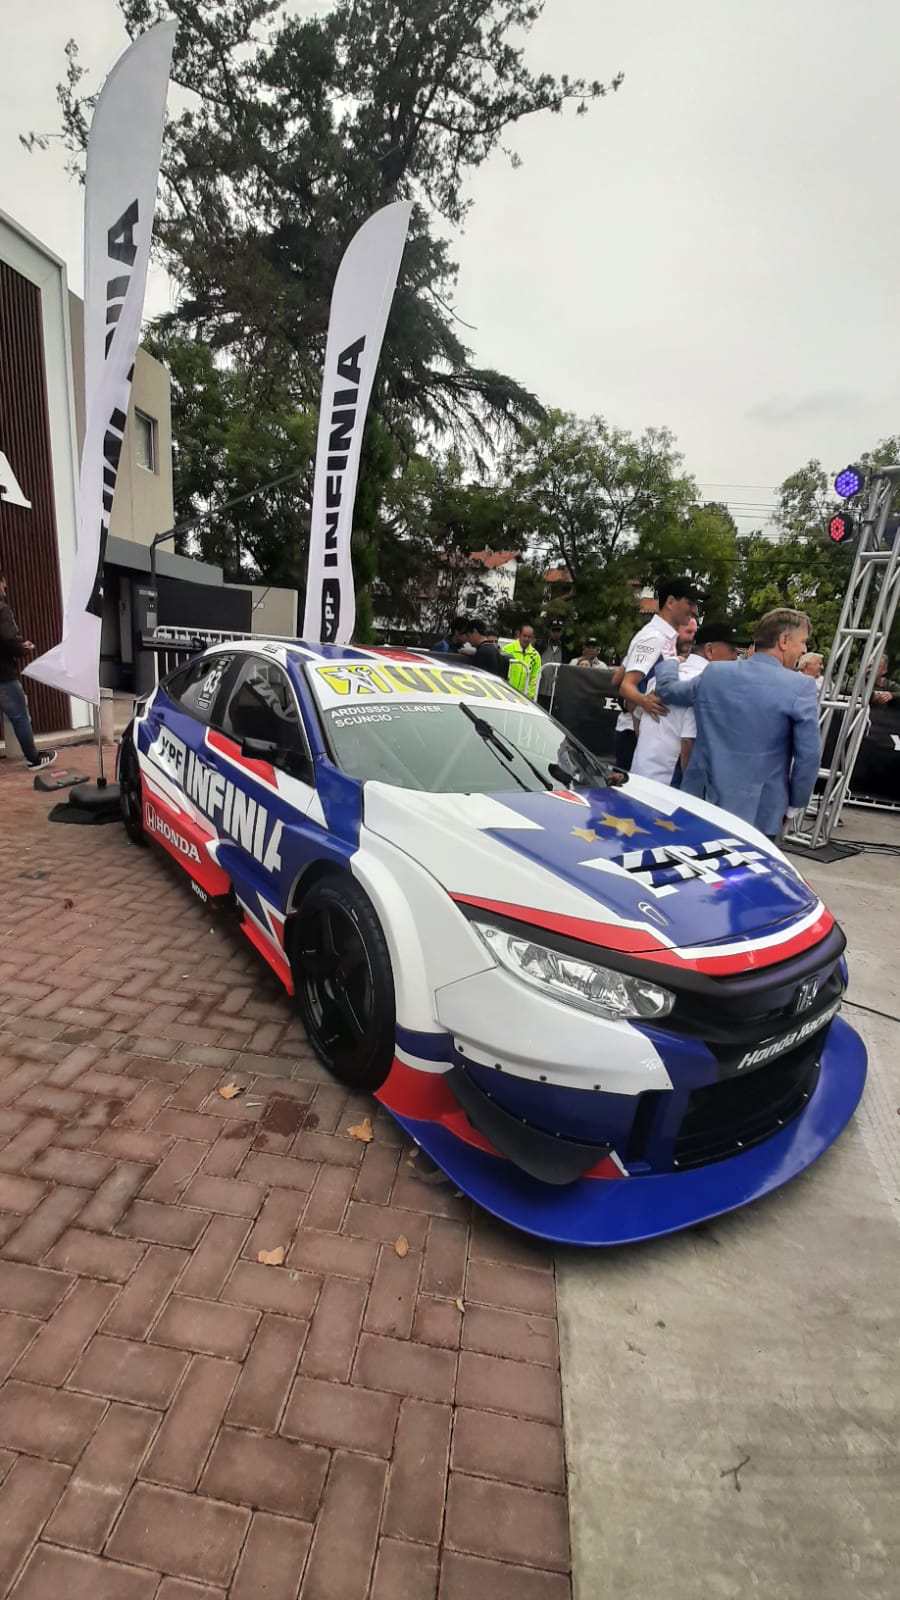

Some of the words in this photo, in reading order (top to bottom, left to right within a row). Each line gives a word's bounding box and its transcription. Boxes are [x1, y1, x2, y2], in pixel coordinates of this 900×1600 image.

[323, 334, 367, 568] INFINIA
[203, 670, 223, 694] 83
[331, 705, 391, 719] ARDUSSO
[399, 705, 444, 713] LLAVER
[335, 714, 392, 728] SCUNCIO
[158, 735, 183, 770] YPF
[156, 815, 202, 865] HONDA
[737, 1030, 798, 1070] Honda
